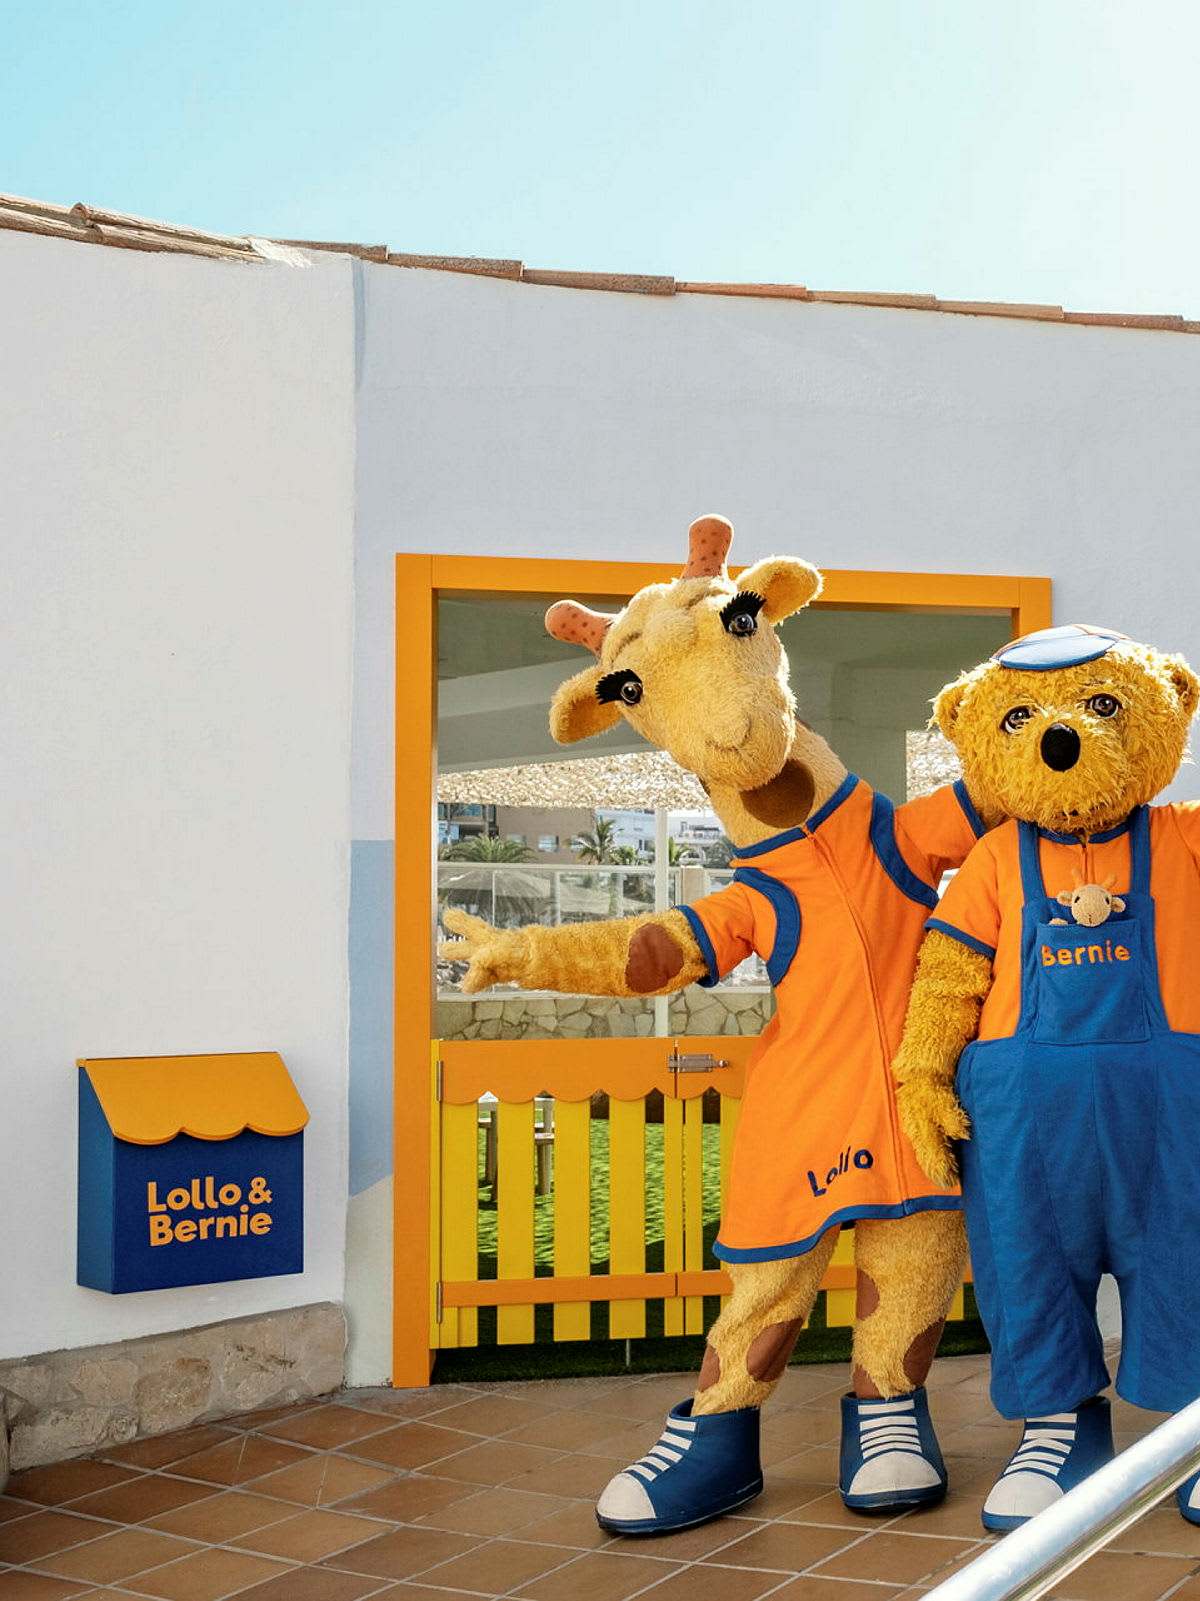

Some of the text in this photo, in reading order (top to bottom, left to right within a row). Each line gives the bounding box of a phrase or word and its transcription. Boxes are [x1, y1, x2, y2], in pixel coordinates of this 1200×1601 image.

[1041, 940, 1131, 967] Bernie
[807, 1145, 874, 1197] Lollo
[147, 1176, 273, 1213] Lollo &
[149, 1204, 273, 1247] Bernie
